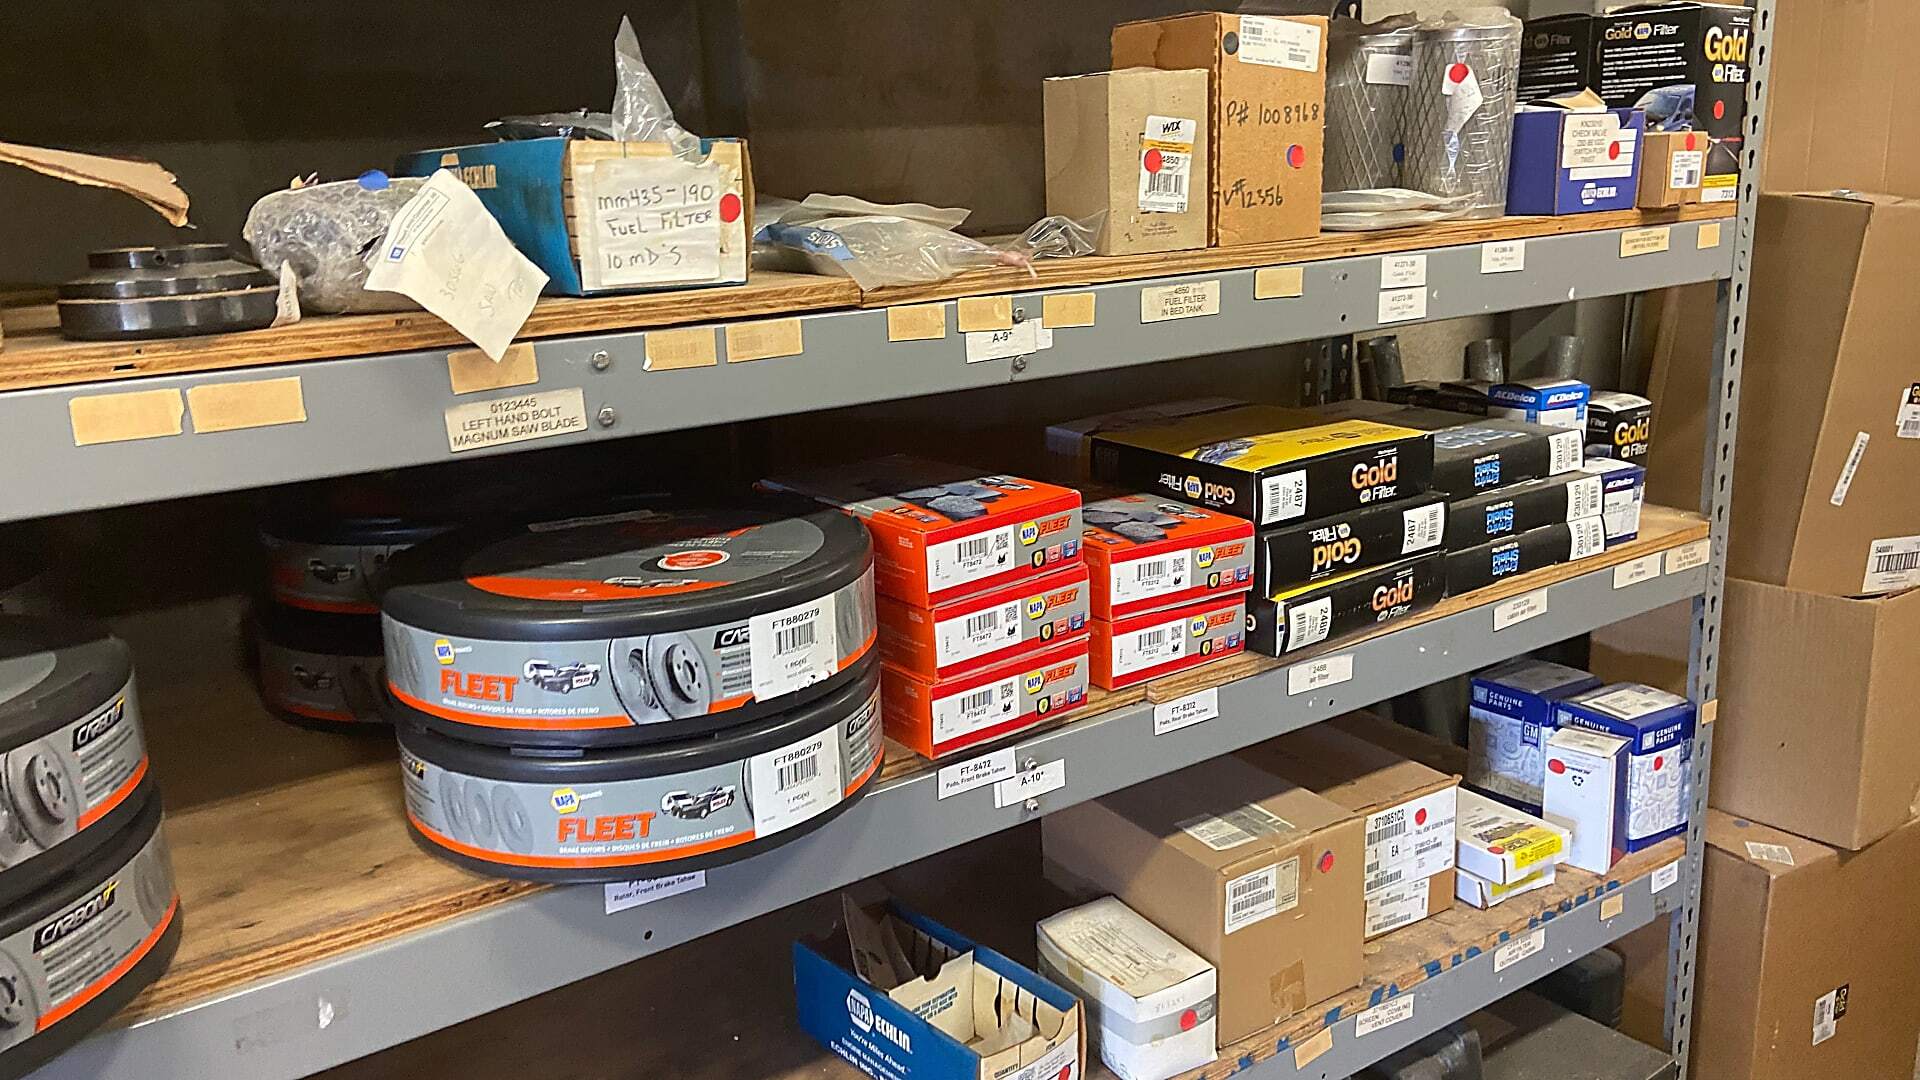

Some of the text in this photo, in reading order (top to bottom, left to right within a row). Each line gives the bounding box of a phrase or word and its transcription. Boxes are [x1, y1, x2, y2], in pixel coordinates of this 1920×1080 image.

[1605, 27, 1632, 40] Gold
[1653, 24, 1679, 36] Filter
[1705, 27, 1748, 62] Gold
[1226, 101, 1320, 126] P# 1008968
[1162, 120, 1182, 134] WIX
[607, 217, 648, 236] FUEL
[607, 252, 622, 270] 10
[1165, 294, 1206, 306] FUEL FILTER
[1161, 304, 1204, 316] IN BED TANK
[490, 397, 537, 413] 0123445
[1494, 390, 1536, 403] ACDelco
[1547, 391, 1584, 404] ACDelco
[462, 406, 561, 431] LEFT HAND BOLT
[453, 417, 580, 447] MAGNUM SAW BLADE
[1615, 418, 1650, 446] Gold
[1631, 443, 1648, 457] Filter
[1352, 455, 1398, 489] Gold
[1474, 461, 1501, 477] Shield
[1158, 472, 1182, 490] Filter
[1605, 477, 1635, 489] ACDelco
[1204, 482, 1236, 504] Gold
[1294, 480, 1303, 508] 2487
[1373, 486, 1396, 499] Filter
[1486, 505, 1515, 524] Shield
[1022, 515, 1071, 540] NAPA FLEET
[1311, 526, 1337, 542] Filter
[1407, 519, 1415, 546] 2487
[1199, 543, 1245, 562] NAPA FLEET
[1312, 537, 1361, 572] Gold
[1492, 549, 1519, 566] Shield
[1029, 588, 1079, 613] NAPA FLEET
[1372, 576, 1414, 612] Gold
[772, 608, 820, 630] FT880279
[1319, 607, 1329, 635] 2488
[1387, 605, 1411, 618] Filter
[1193, 620, 1205, 632] NAPA
[1207, 612, 1237, 628] FLEET
[1027, 663, 1077, 688] NAPA FLEET
[439, 669, 520, 702] FLEET
[1488, 699, 1512, 711] PARTS
[1490, 691, 1523, 708] GENUINE
[1524, 725, 1538, 739] GM
[1574, 717, 1611, 733] GENUINE
[1656, 723, 1682, 738] GENUINE
[1656, 734, 1674, 745] PARTS
[774, 741, 823, 767] FT880279
[960, 759, 992, 776] FT-8472
[976, 771, 991, 780] Brake
[991, 766, 1006, 776] Tahoe
[557, 812, 656, 843] FLEET
[1391, 845, 1399, 857] EA
[614, 888, 635, 901] Rotor,
[636, 884, 654, 896] Front
[655, 879, 675, 891] Brake
[676, 874, 696, 886] Tahoe
[850, 997, 871, 1026] NAPA
[875, 1015, 911, 1053] ECHLIN
[830, 1040, 858, 1066] ECHLIN
[850, 1028, 868, 1047] You're
[868, 1041, 884, 1059] Miles
[994, 1063, 1019, 1078] QUANTITY
